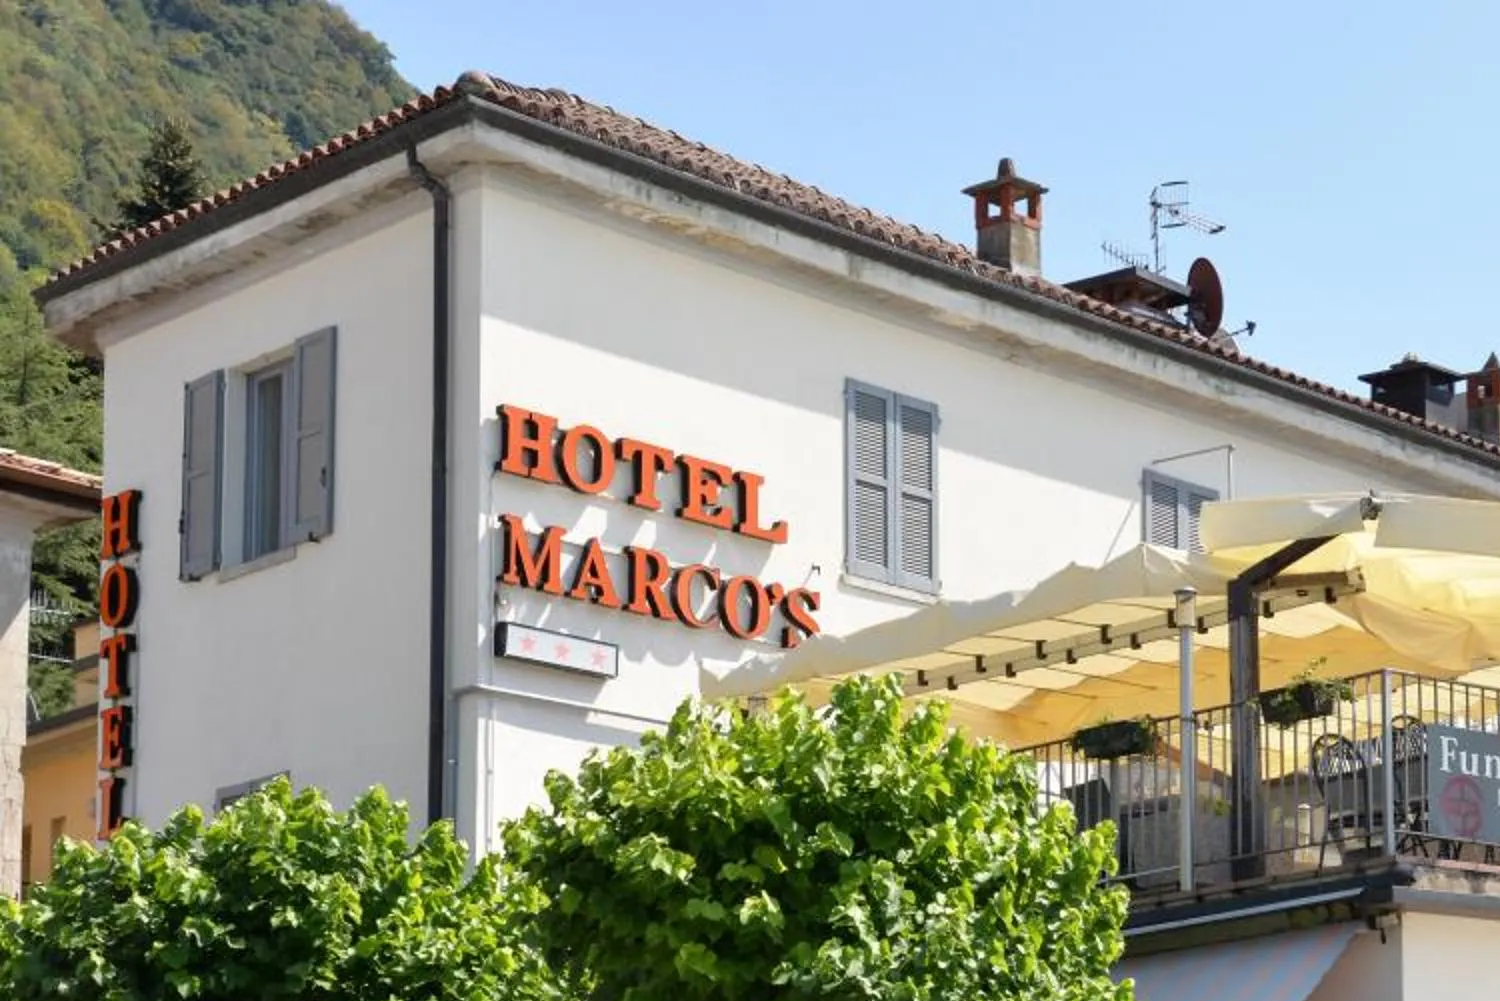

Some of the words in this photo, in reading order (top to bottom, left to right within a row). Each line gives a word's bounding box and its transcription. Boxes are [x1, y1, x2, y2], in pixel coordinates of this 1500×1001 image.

[496, 403, 788, 544] HOTEL
[497, 512, 821, 649] MARCO'S
[98, 490, 142, 841] HOTEL
